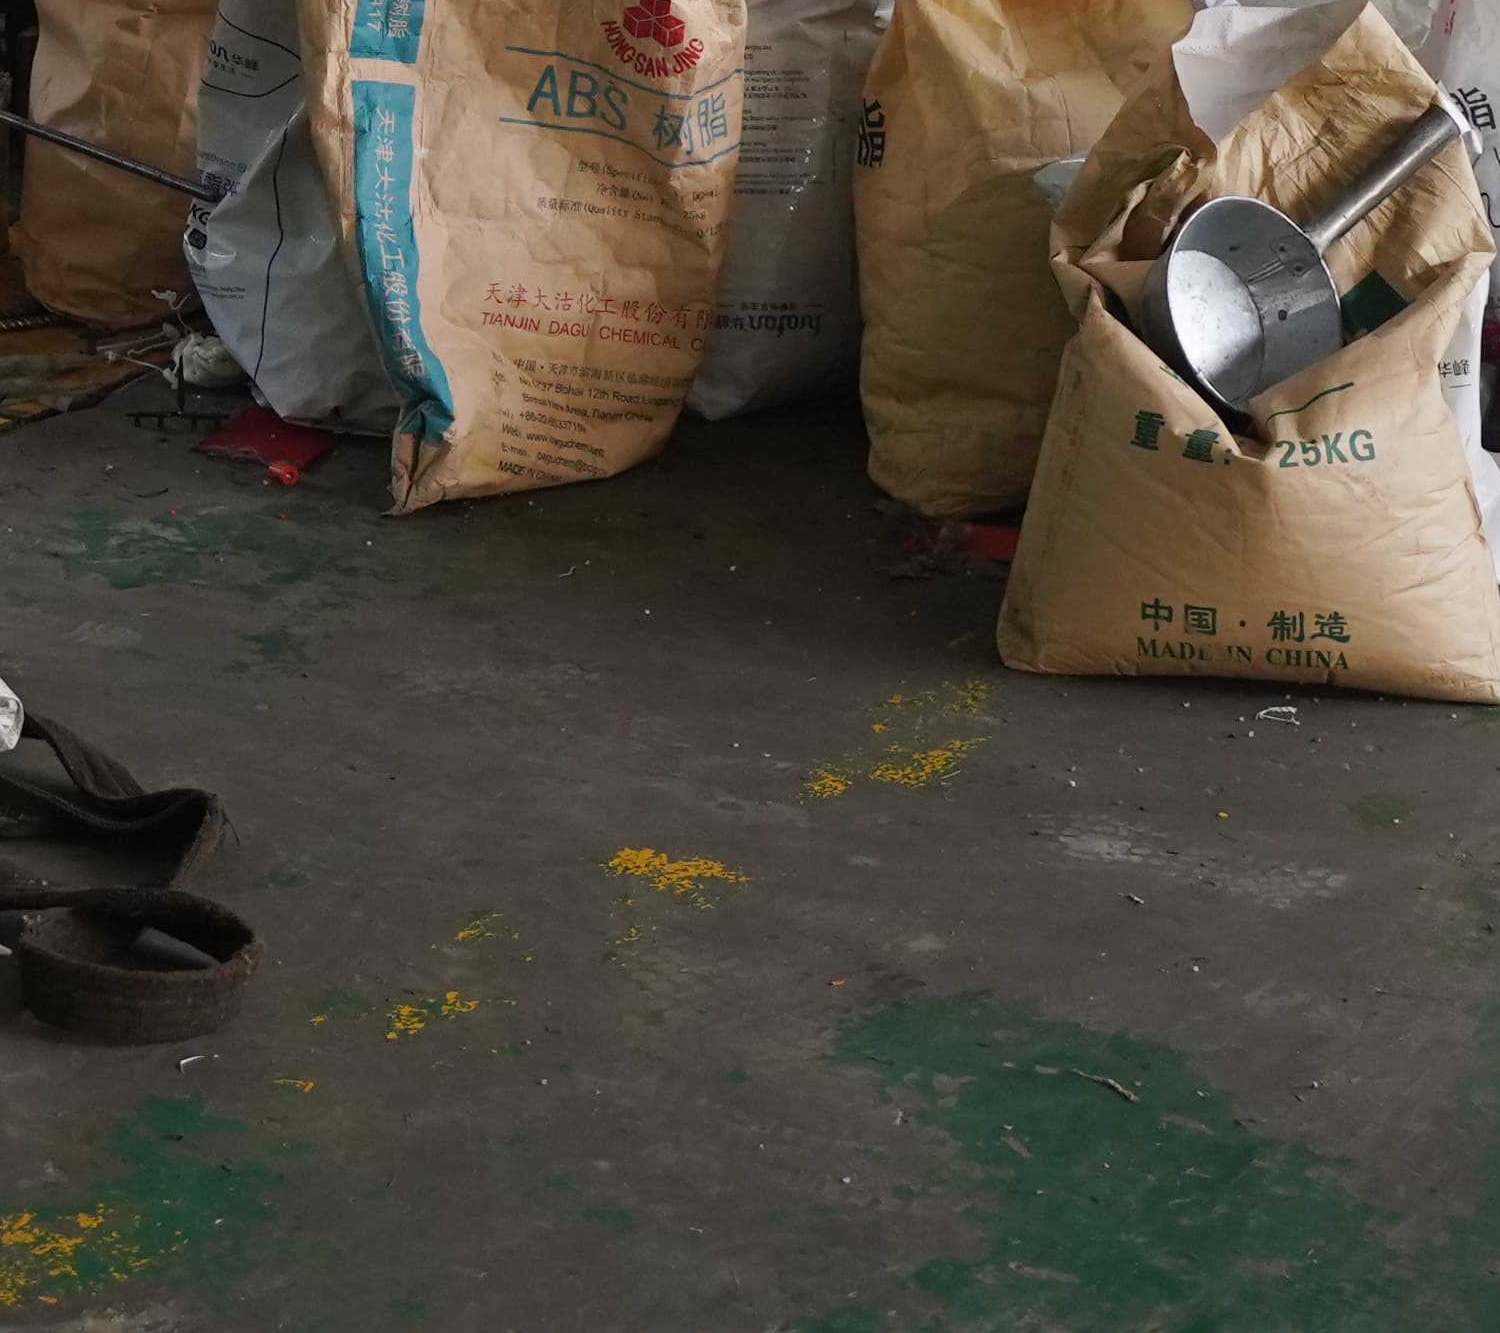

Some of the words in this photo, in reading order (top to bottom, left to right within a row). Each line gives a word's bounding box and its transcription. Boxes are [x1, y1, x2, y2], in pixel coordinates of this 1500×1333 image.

[601, 19, 638, 66] HONG
[633, 52, 669, 79] SAN
[672, 37, 706, 75] JING
[526, 64, 630, 131] ABS
[653, 92, 729, 157] 树脂
[481, 311, 541, 333] TIANJIN
[549, 320, 592, 338] DAGU
[599, 325, 681, 350] CHEMICAL
[1275, 429, 1377, 469] 25KG
[1137, 636, 1214, 661] MADE
[1266, 648, 1350, 670] CHINA
